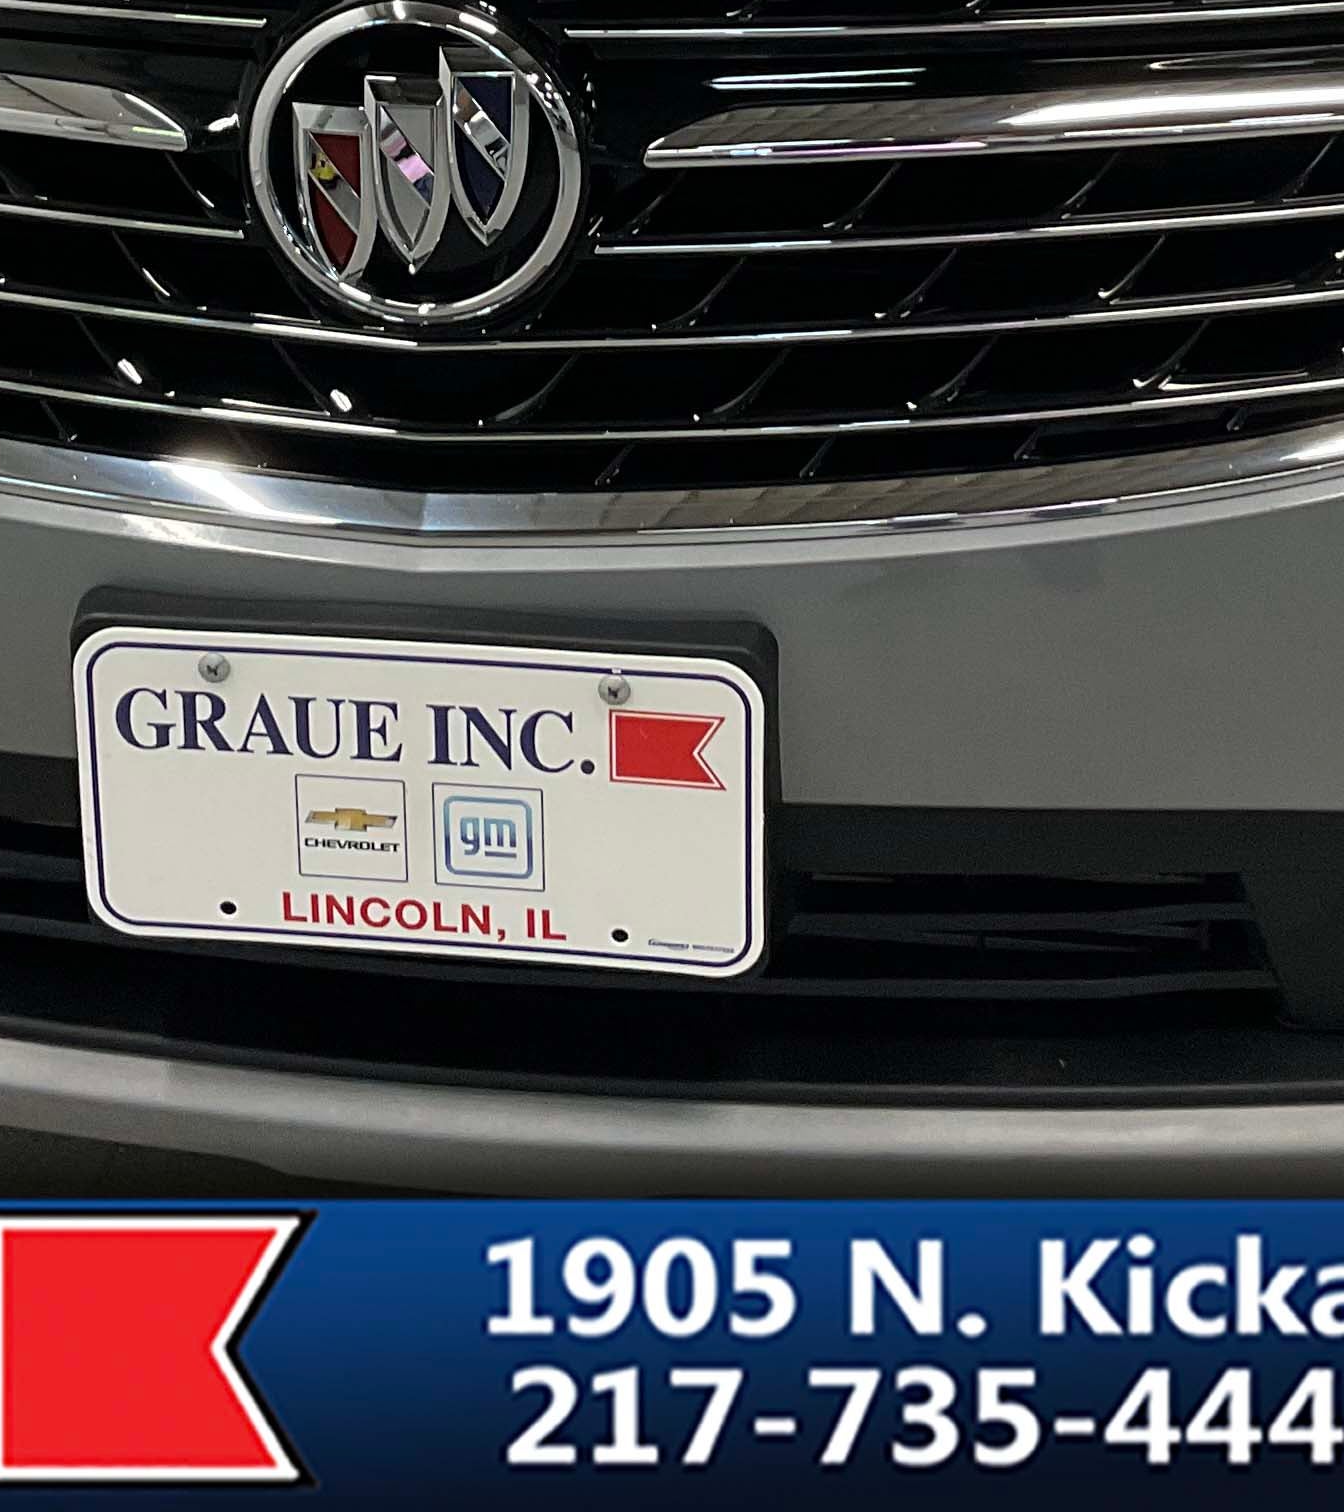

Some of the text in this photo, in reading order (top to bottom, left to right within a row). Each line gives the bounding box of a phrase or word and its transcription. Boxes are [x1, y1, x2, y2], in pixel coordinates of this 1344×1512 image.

[115, 687, 596, 775] GRAUE INC.
[303, 837, 401, 854] CHEVROLET
[282, 891, 567, 942] LINCOLN, IL
